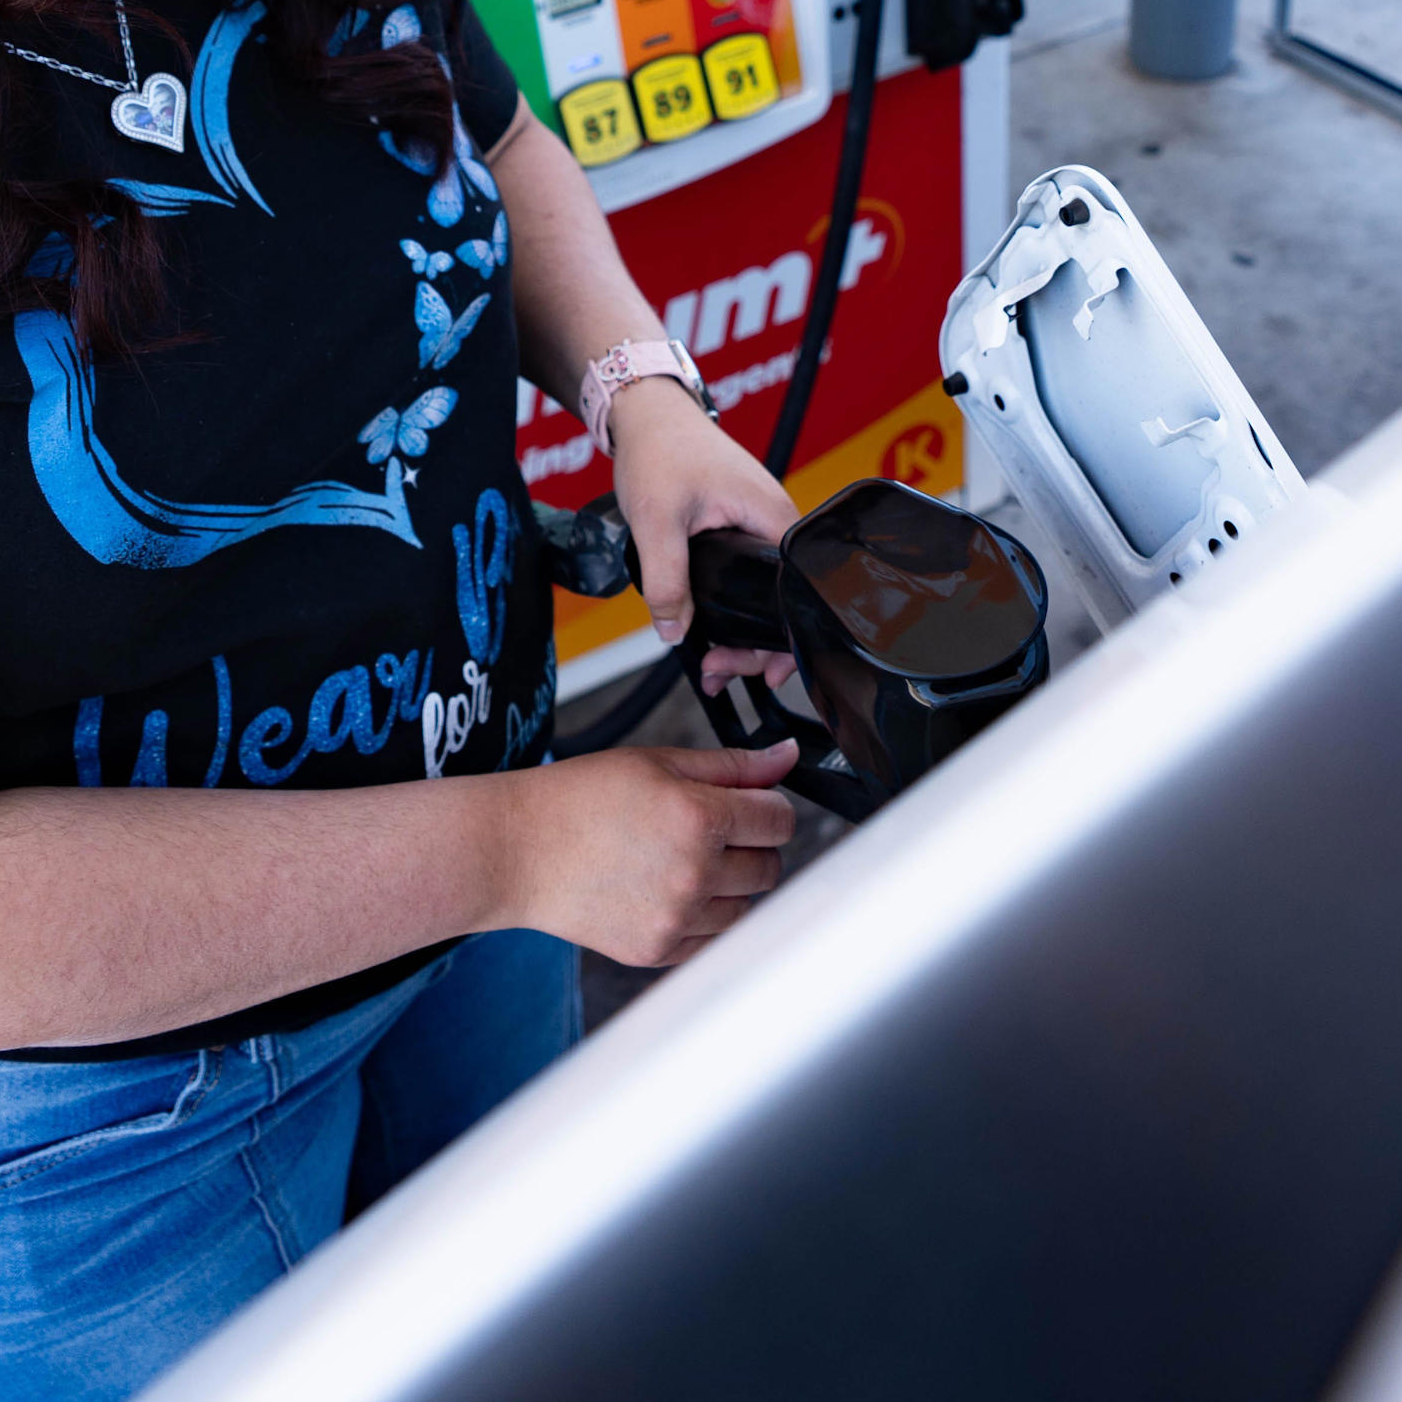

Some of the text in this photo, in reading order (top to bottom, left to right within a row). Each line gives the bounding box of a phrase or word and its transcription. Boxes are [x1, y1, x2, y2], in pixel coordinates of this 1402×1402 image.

[726, 63, 760, 97] 91
[653, 84, 693, 120] 89
[583, 107, 619, 144] 87
